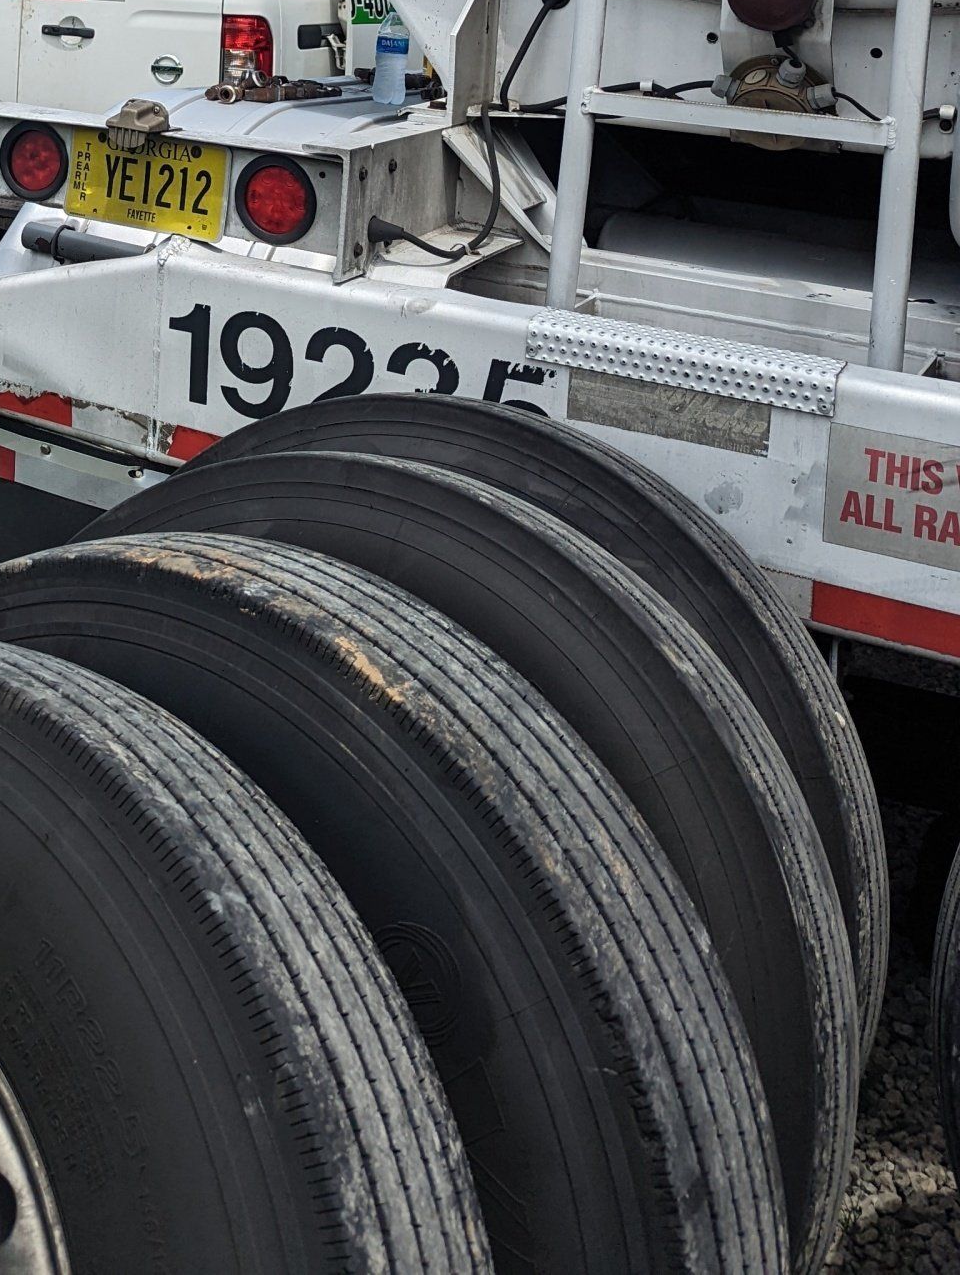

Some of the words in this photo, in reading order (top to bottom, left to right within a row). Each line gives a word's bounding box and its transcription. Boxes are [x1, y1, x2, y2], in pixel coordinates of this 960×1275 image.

[106, 136, 192, 163] GRGIA
[72, 151, 83, 190] PERM
[126, 208, 157, 223] FAYETTE
[864, 447, 945, 495] THIS
[840, 490, 903, 534] ALL
